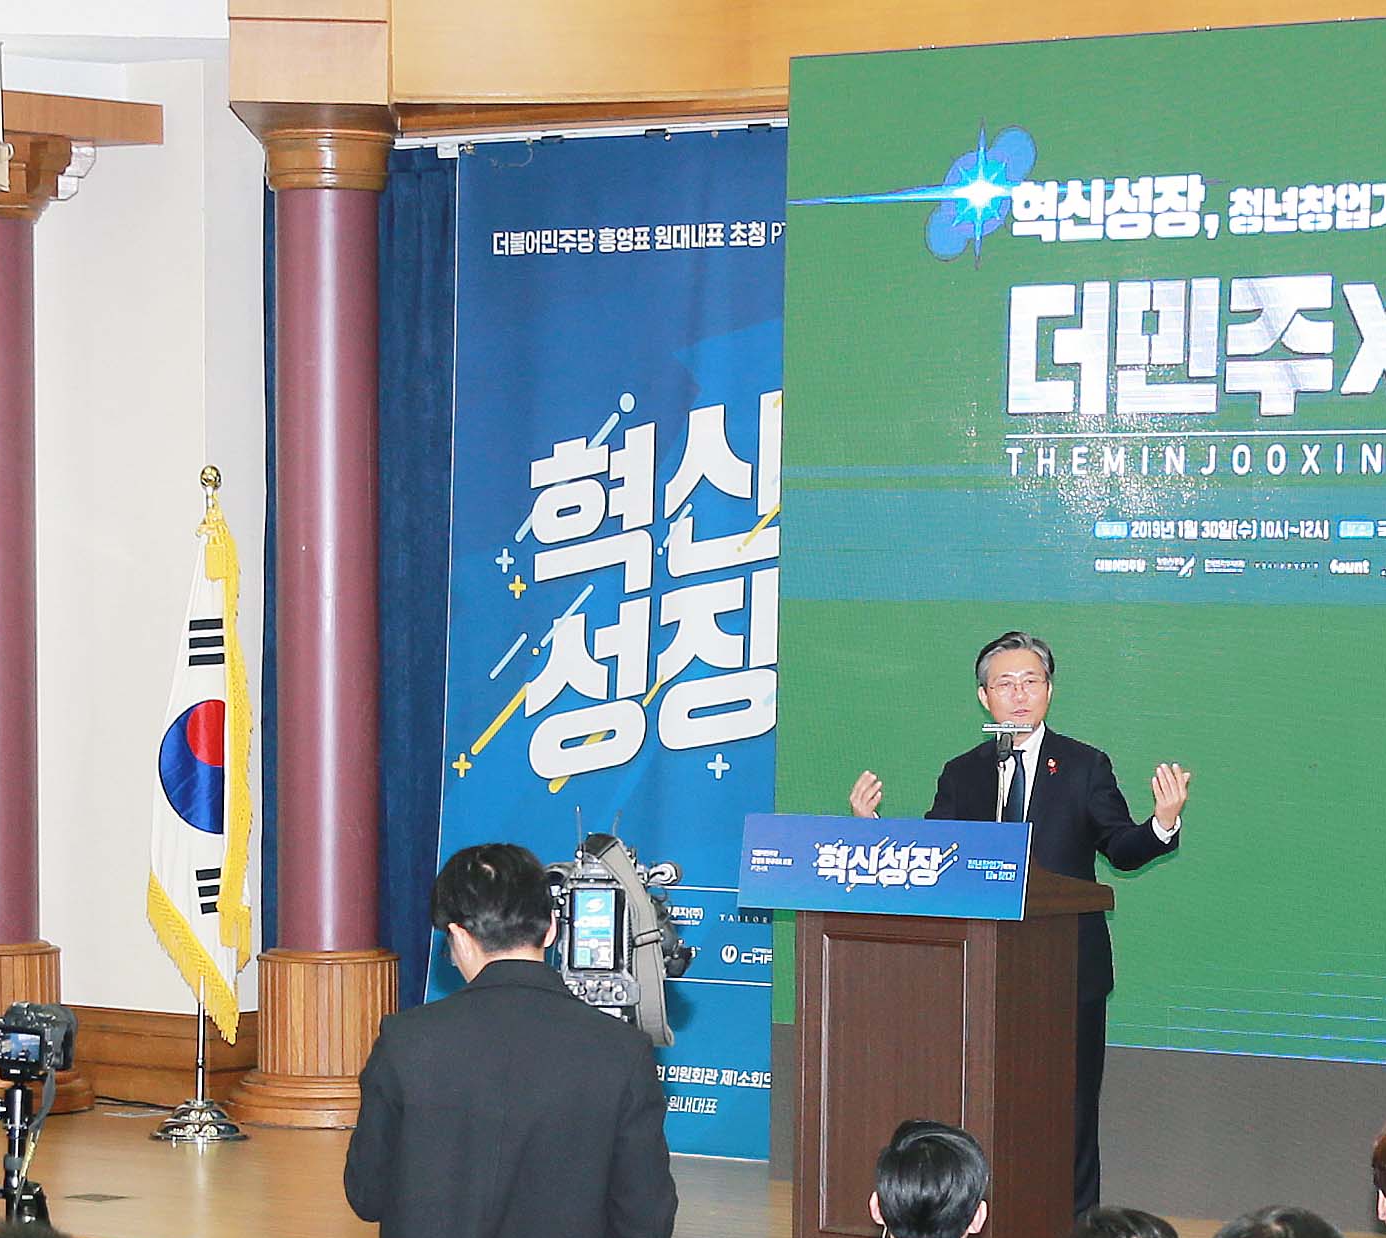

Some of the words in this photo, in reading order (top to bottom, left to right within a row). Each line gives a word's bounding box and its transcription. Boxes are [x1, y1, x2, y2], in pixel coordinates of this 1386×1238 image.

[1011, 172, 1220, 242] 혁신성장,
[492, 229, 595, 256] 더불어민주당
[598, 226, 651, 253] 홍영표
[654, 223, 725, 251] 원대내표
[728, 220, 767, 248] 초청
[530, 388, 784, 595] 혁신
[1131, 520, 1175, 540] 2019년
[1177, 519, 1199, 540] 1월
[1201, 519, 1257, 541] 30일(수)
[1260, 519, 1330, 541] 10시~12시
[816, 843, 944, 886] 혁신성장
[667, 1065, 719, 1085] 의원회관
[667, 1095, 719, 1115] 원내대표
